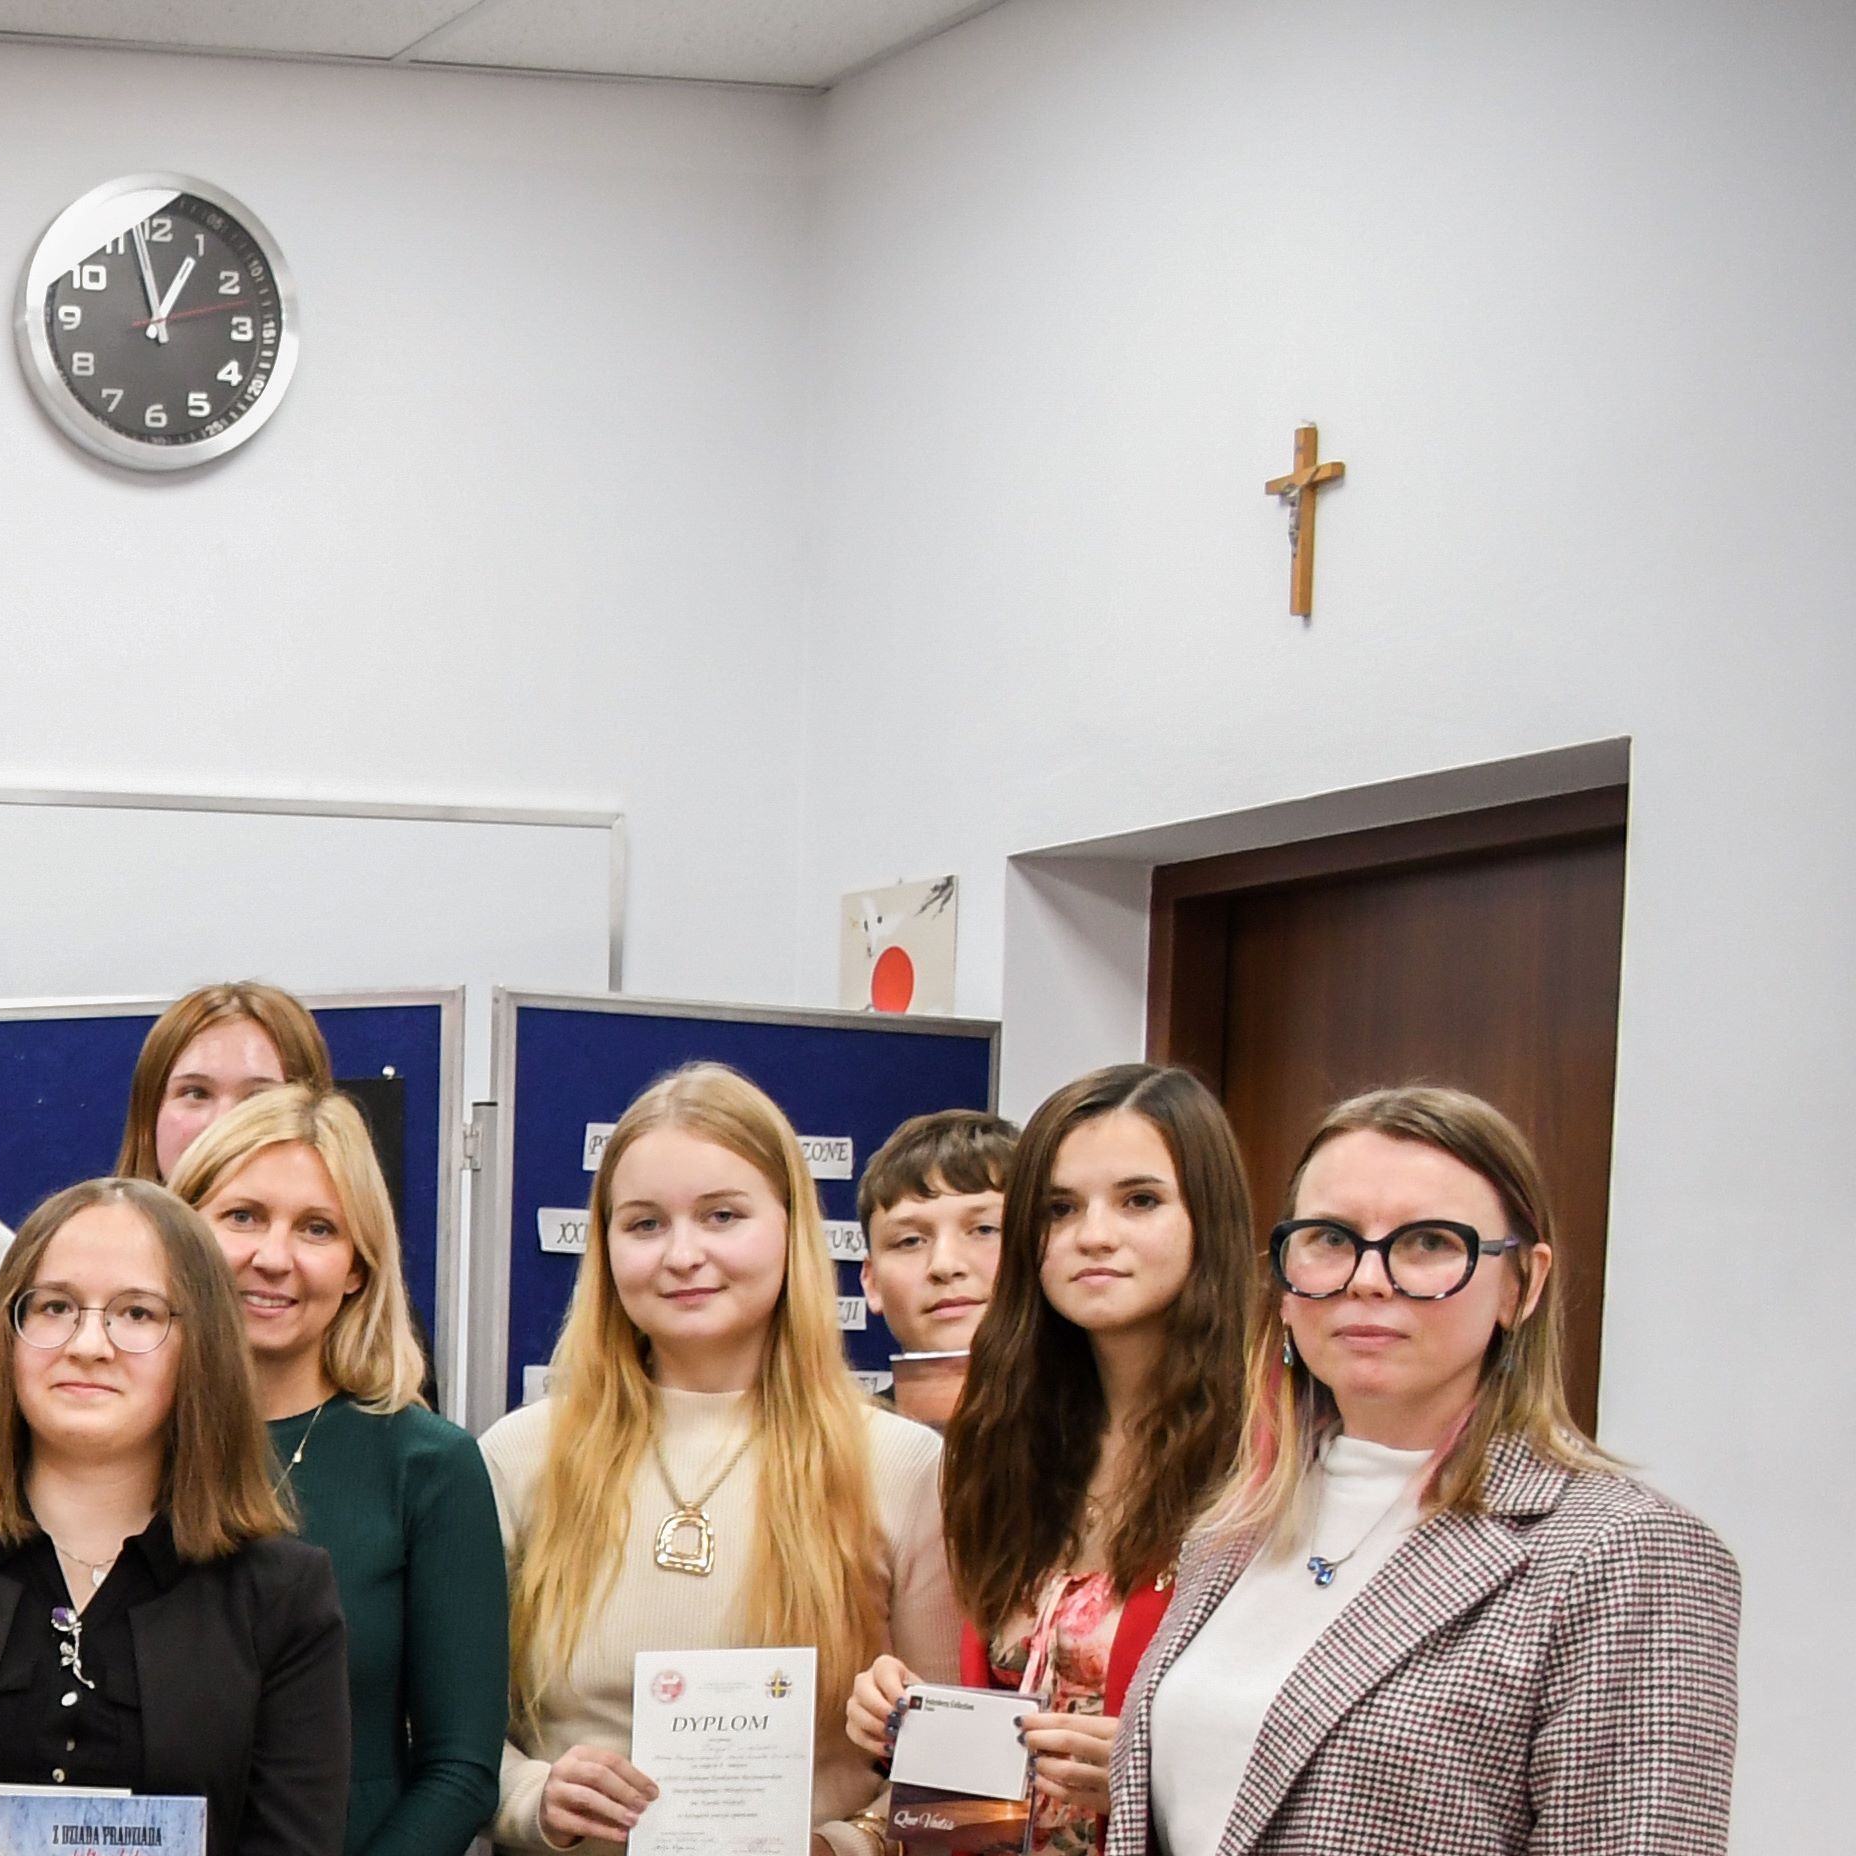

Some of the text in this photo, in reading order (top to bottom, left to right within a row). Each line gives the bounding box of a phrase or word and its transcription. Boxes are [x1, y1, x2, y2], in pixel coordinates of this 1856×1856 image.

[195, 233, 205, 257] 1
[72, 264, 107, 291] 10
[218, 270, 241, 295] 2
[58, 305, 81, 330] 9
[230, 316, 253, 342] 3
[71, 351, 95, 376] 8
[216, 359, 243, 387] 4
[100, 388, 124, 413] 7
[187, 392, 211, 417] 5
[144, 404, 168, 428] 6
[672, 1715, 769, 1732] DYPLOM
[52, 1825, 162, 1846] Z DZIADA PRADZIADA
